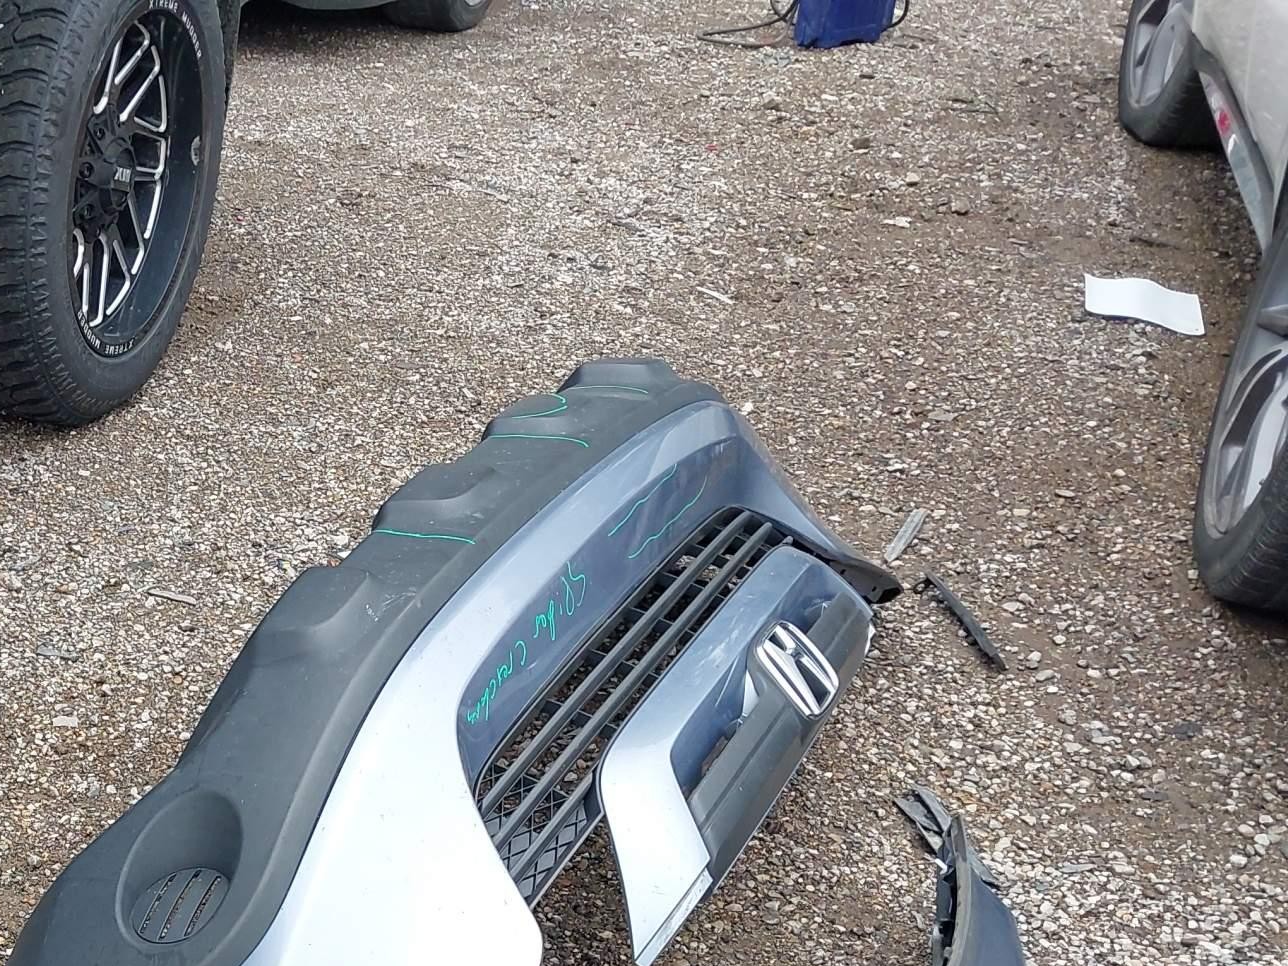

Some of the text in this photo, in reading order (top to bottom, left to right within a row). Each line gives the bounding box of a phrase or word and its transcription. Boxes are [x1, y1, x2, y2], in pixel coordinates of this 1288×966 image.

[182, 10, 202, 60] MUDDER
[77, 309, 134, 356] XTREME MUDDER
